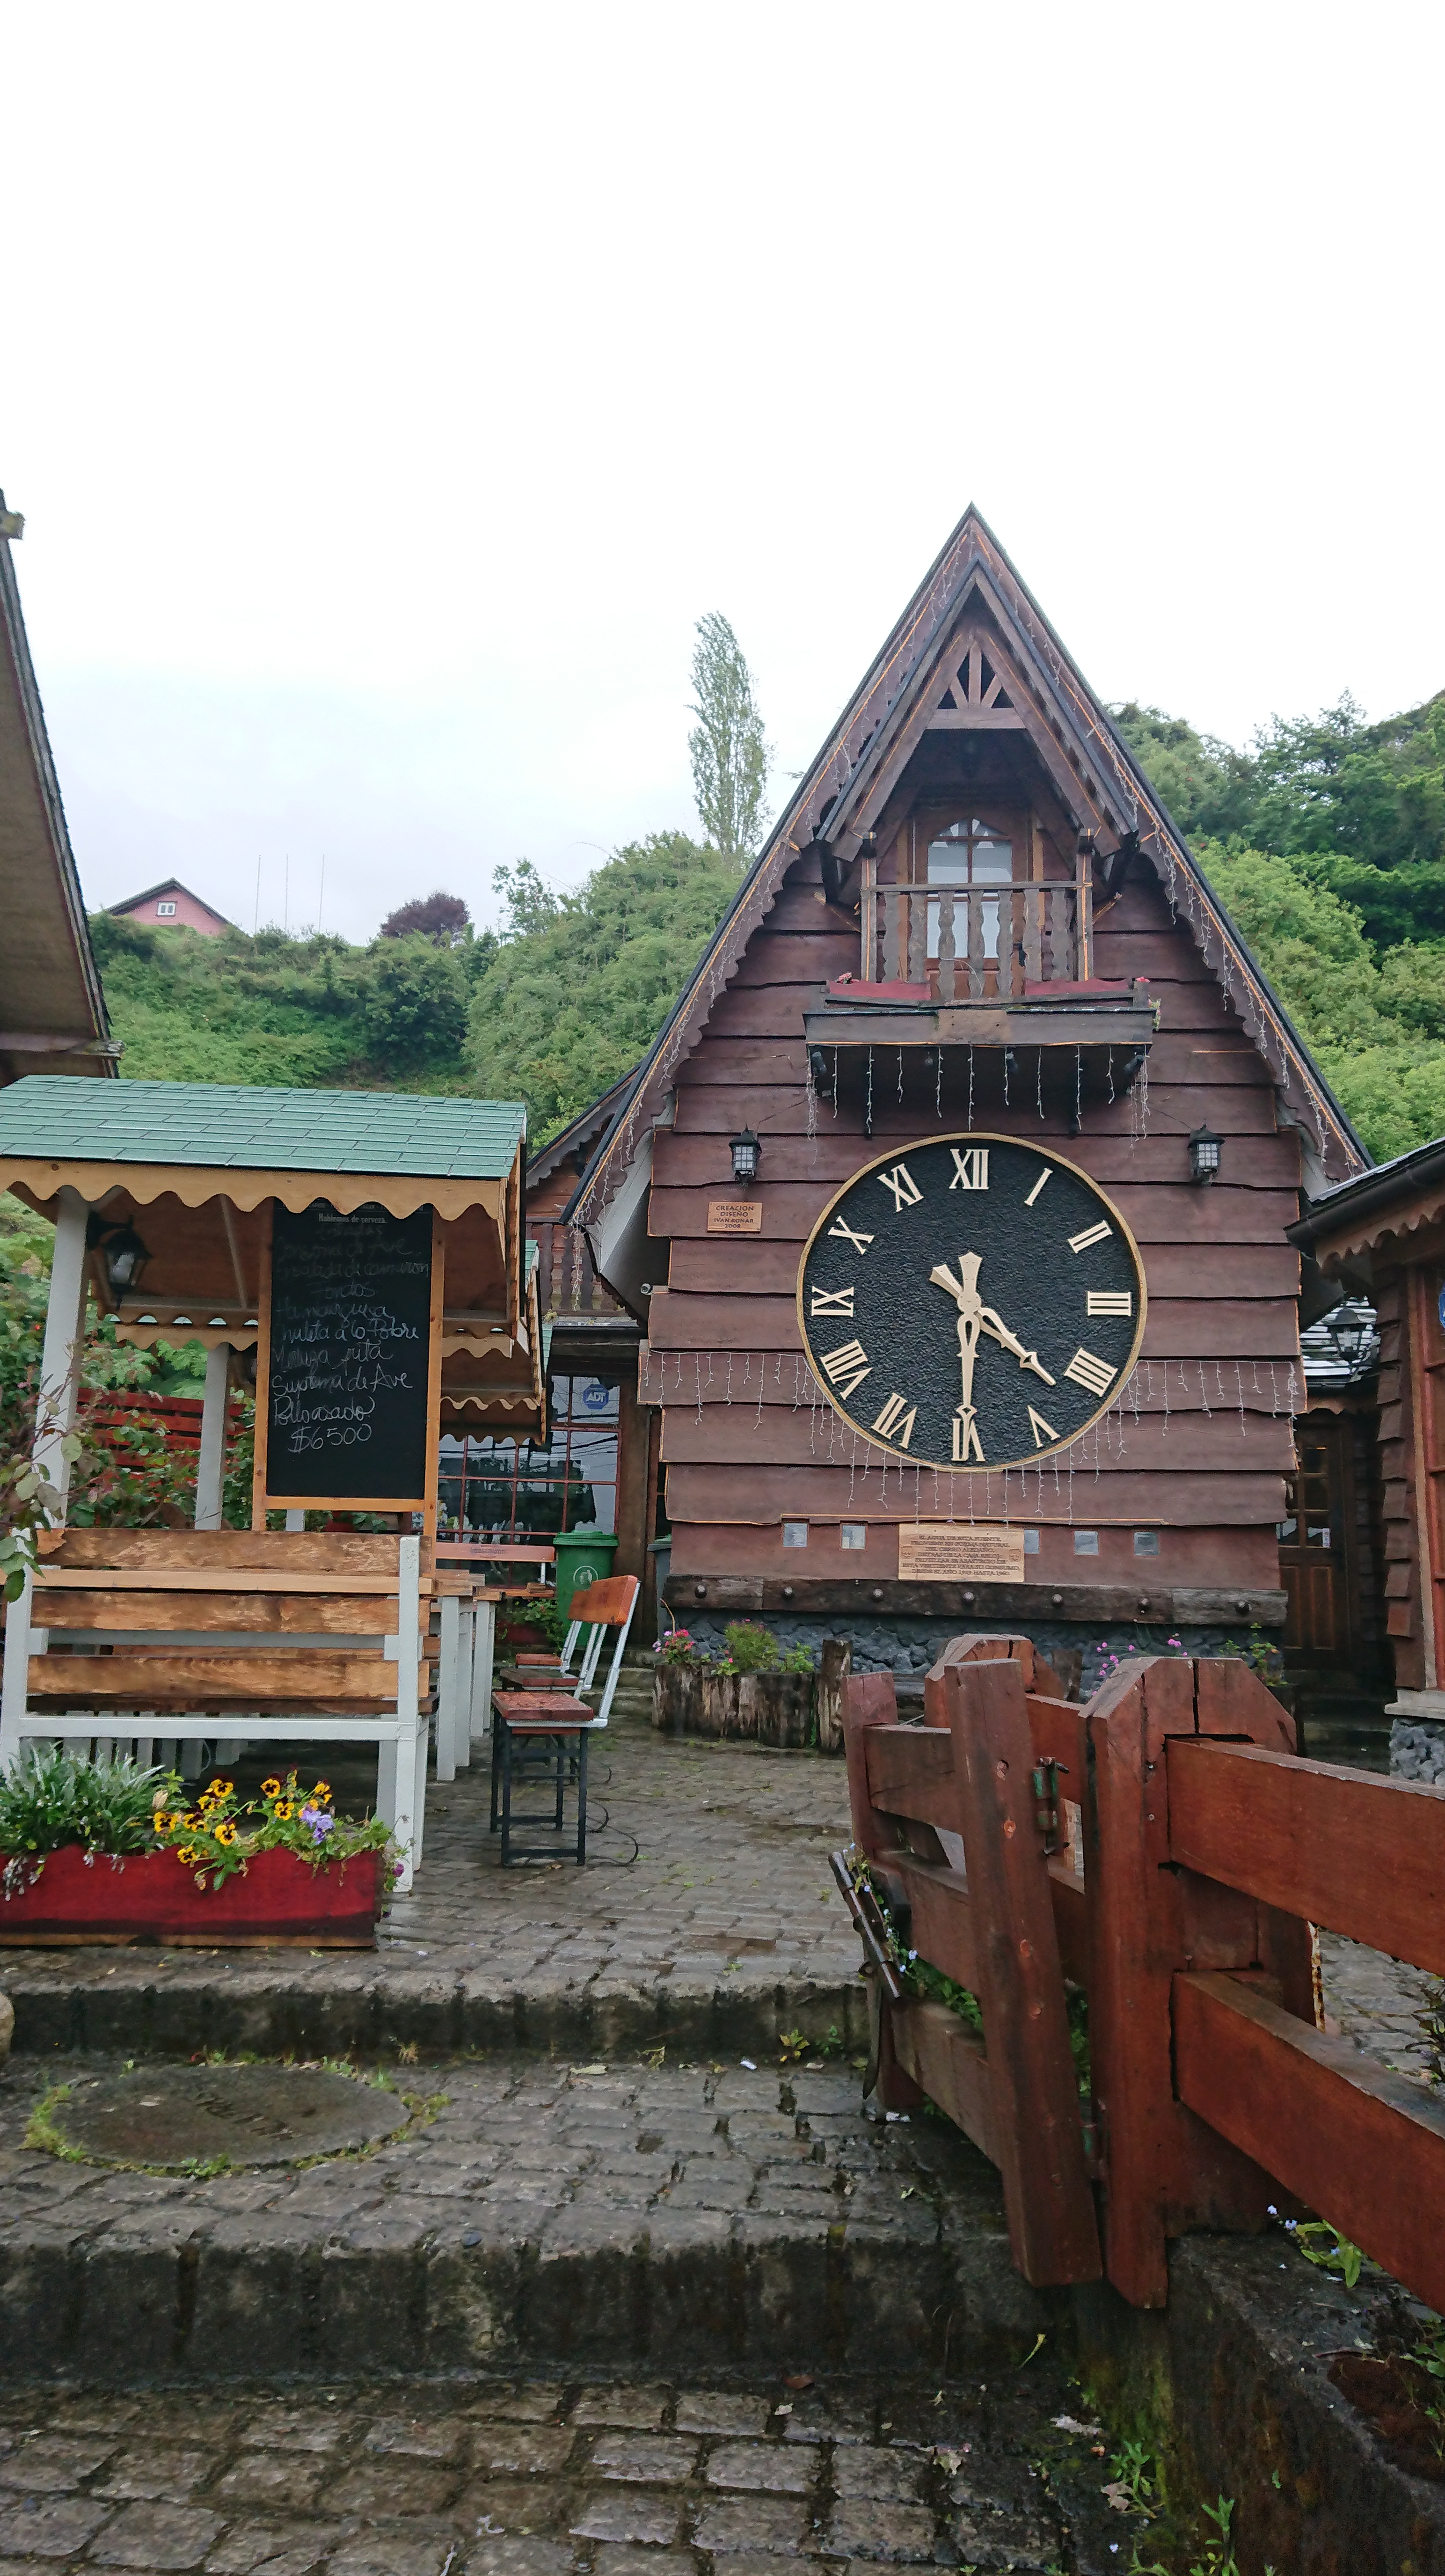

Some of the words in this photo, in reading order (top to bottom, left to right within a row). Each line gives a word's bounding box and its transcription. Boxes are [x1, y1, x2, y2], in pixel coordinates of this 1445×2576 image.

[877, 1163, 925, 1212] XI
[949, 1149, 989, 1190] XII
[1024, 1167, 1053, 1206] I
[319, 1213, 350, 1222] Hablemos
[351, 1215, 359, 1223] de
[827, 1216, 875, 1255] X
[1067, 1220, 1114, 1254] II
[811, 1285, 854, 1317] IX
[1087, 1290, 1131, 1317] III
[335, 1328, 348, 1342] a
[347, 1366, 369, 1391] de
[369, 1362, 414, 1393] Ave
[819, 1339, 873, 1400] VIII
[586, 1392, 606, 1402] ADT
[871, 1392, 918, 1449] VII
[1027, 1405, 1060, 1448] V
[952, 1419, 985, 1462] VI
